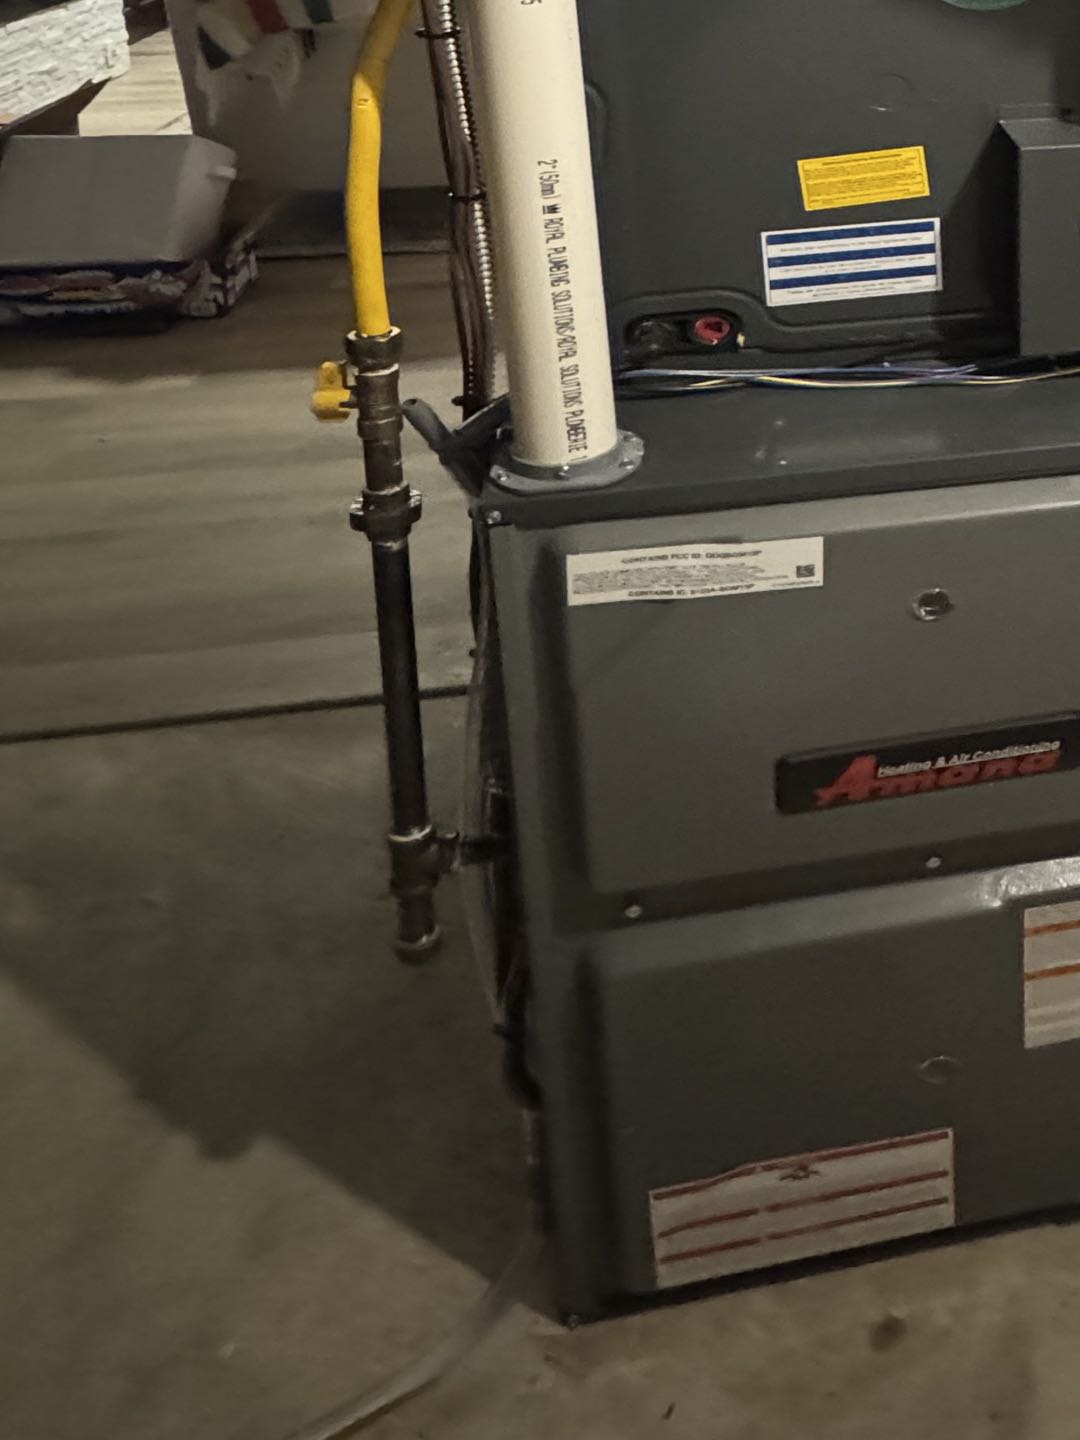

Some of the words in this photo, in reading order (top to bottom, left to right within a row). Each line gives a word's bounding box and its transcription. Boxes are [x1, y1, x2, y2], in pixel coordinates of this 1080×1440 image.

[544, 217, 565, 244] ROYAL
[548, 246, 571, 287] PLUMBING
[560, 364, 583, 408] SOLUTIONS
[565, 409, 588, 453] PLOMBERIE
[621, 553, 668, 564] CONTAINS
[628, 589, 675, 597] CONTAINS
[878, 759, 931, 778] Heating
[935, 756, 949, 768] &
[949, 753, 971, 765] Air
[972, 740, 1062, 761] Conditioning
[814, 750, 1062, 808] Amana
